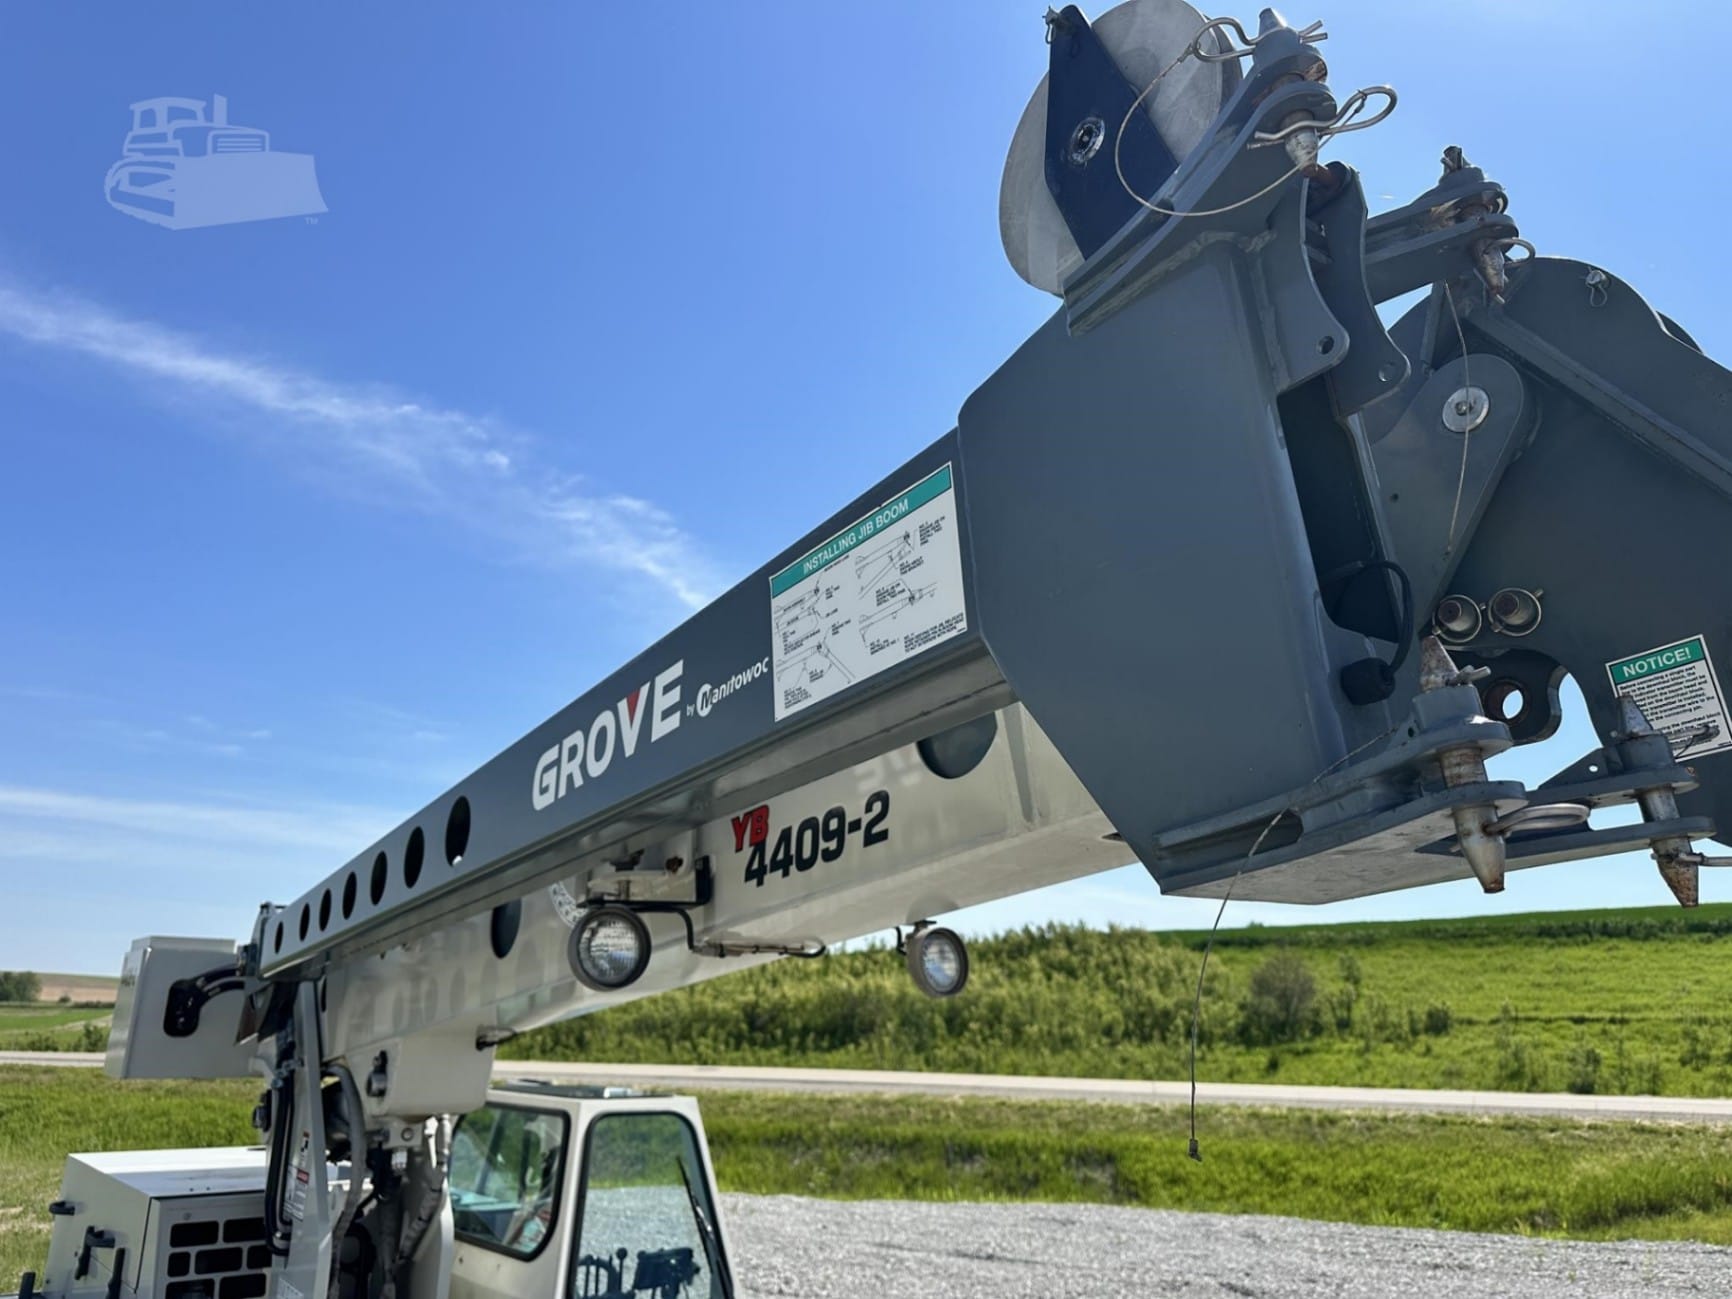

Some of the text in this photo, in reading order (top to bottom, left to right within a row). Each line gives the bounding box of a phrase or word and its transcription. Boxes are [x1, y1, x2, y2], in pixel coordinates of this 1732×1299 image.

[803, 532, 856, 574] INSTALLING
[858, 522, 874, 540] JIB
[876, 498, 909, 528] BOOM
[1622, 647, 1692, 678] NOTICE!
[532, 659, 684, 811] GROVE
[686, 704, 695, 716] by
[696, 656, 770, 718] Manitowoc
[731, 804, 770, 853] YB
[744, 790, 890, 888] 4409-2
